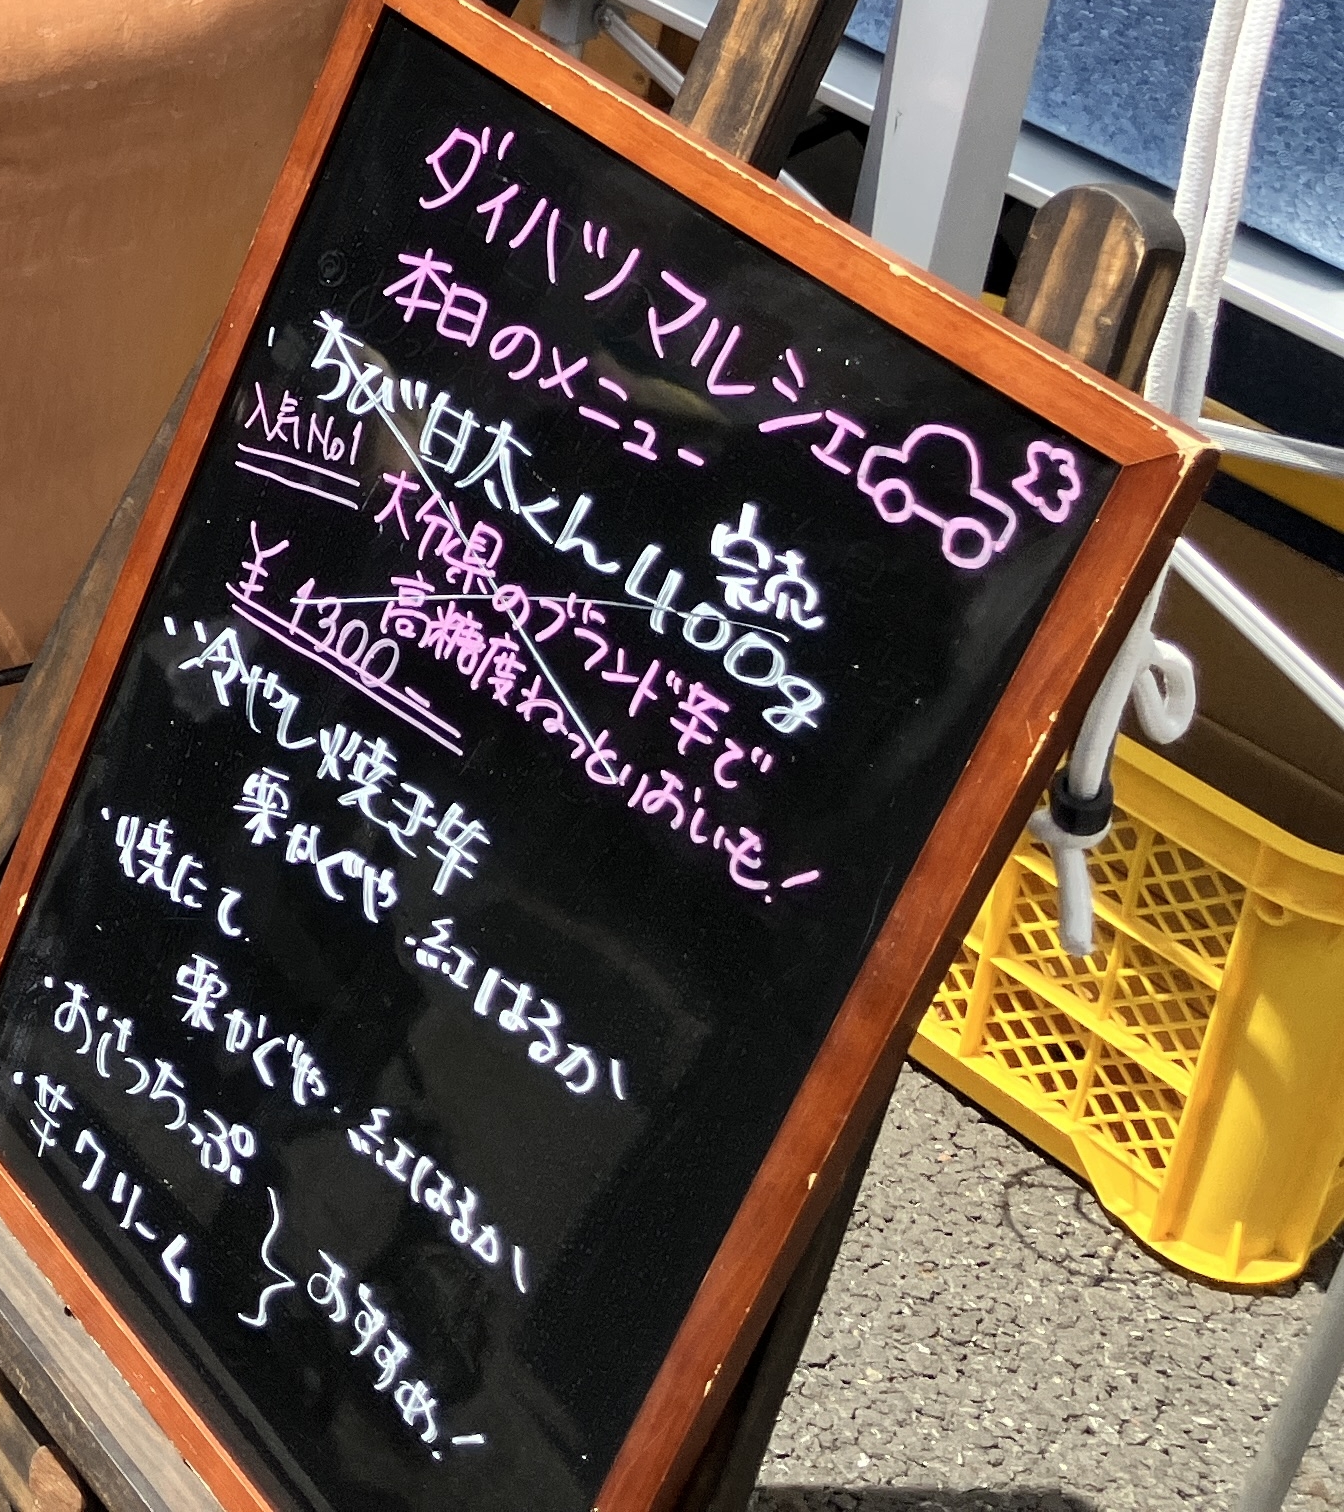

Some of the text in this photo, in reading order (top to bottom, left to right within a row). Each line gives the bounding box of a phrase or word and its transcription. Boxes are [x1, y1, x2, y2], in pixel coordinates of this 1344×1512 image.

[382, 247, 705, 467] 本日のメニュー
